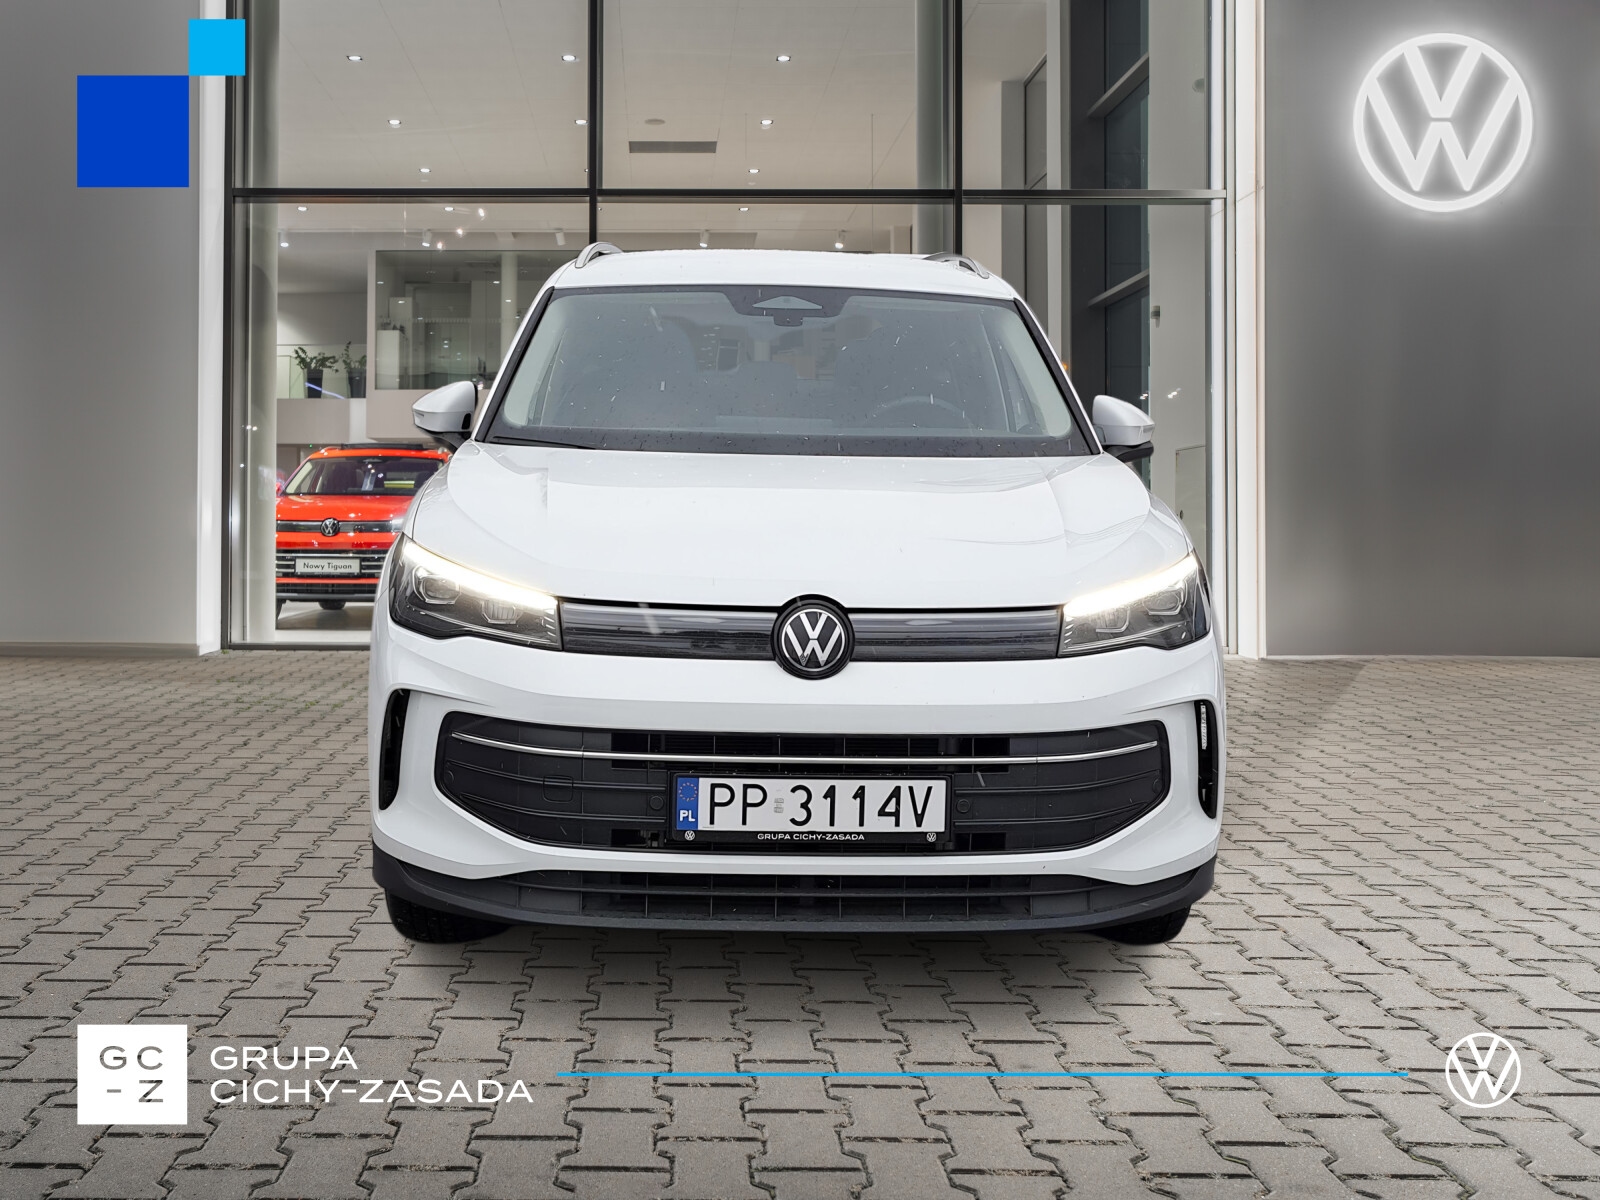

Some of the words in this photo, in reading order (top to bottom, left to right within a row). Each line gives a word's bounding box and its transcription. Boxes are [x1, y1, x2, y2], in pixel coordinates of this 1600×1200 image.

[303, 562, 325, 570] Nowy
[327, 562, 352, 570] Tiguan
[709, 783, 768, 826] PP
[789, 785, 933, 828] 3114V
[679, 810, 696, 822] PL
[793, 833, 865, 841] CICHY-ZASADA
